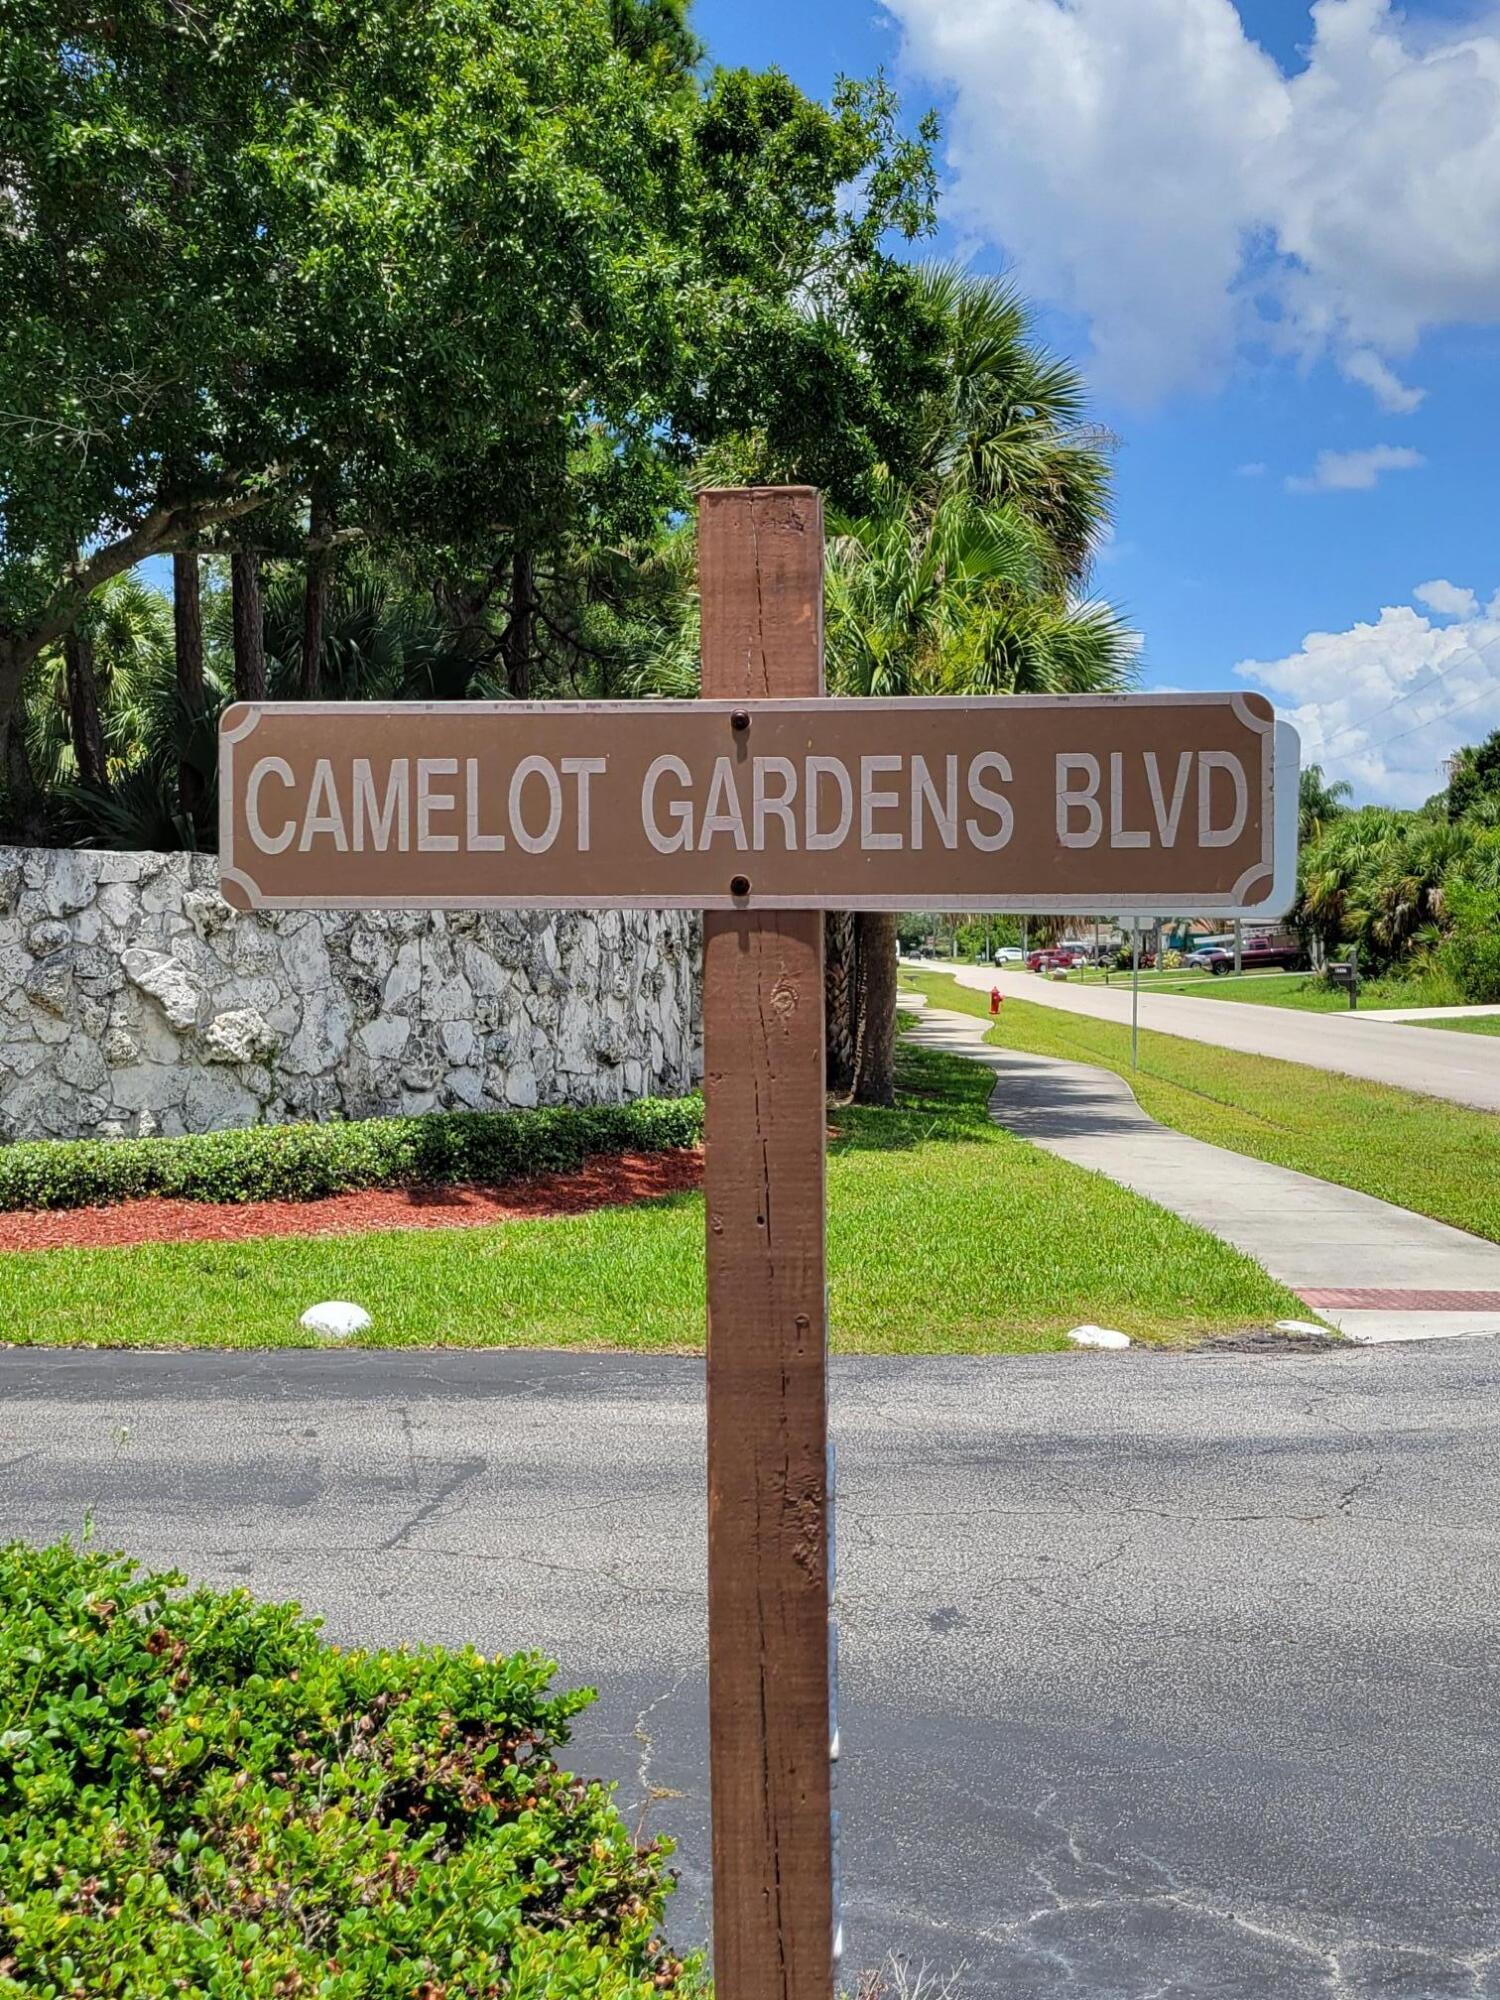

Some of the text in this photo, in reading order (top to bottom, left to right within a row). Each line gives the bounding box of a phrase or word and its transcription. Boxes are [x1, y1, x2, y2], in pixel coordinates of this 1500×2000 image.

[245, 750, 1248, 854] CAMELOT GARDENS BLVD
